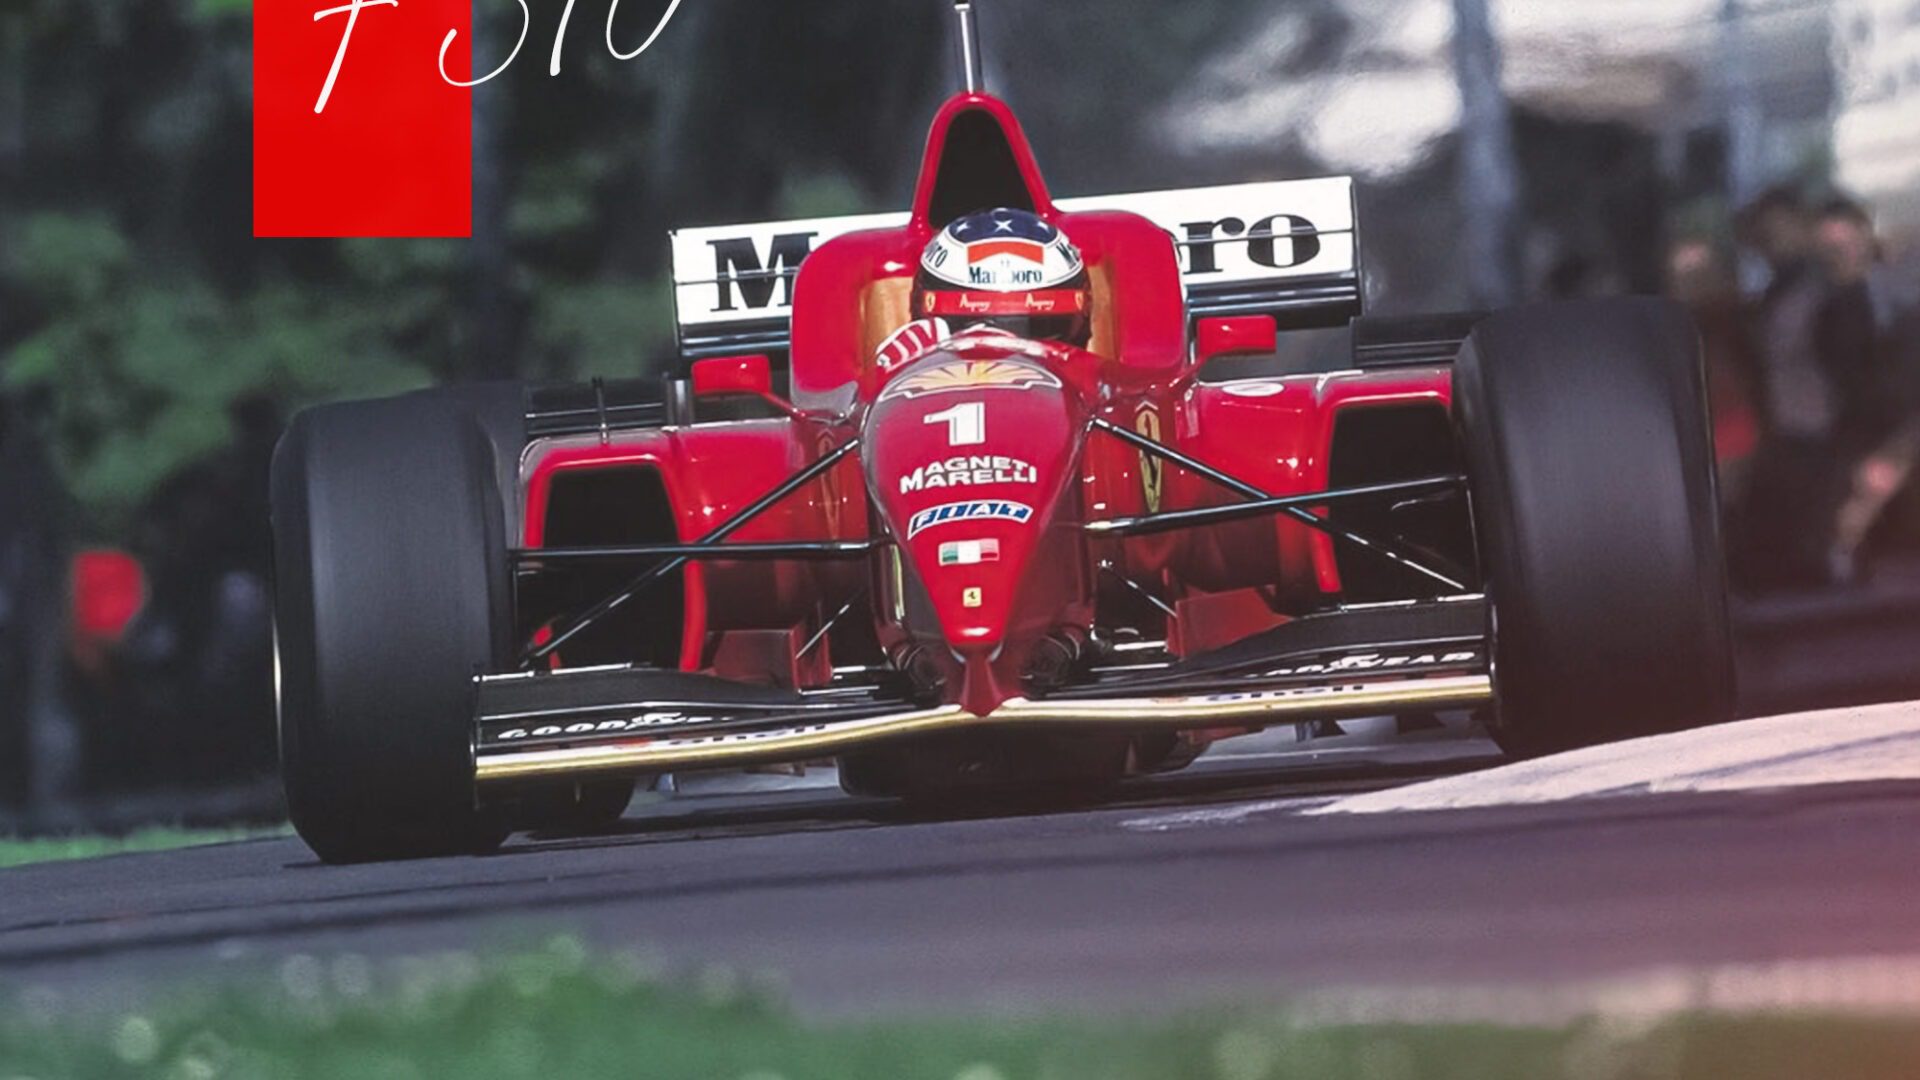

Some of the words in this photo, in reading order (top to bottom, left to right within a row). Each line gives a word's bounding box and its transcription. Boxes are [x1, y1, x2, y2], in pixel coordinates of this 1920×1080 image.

[968, 266, 1043, 284] Maoro
[923, 402, 986, 446] 1
[900, 466, 1037, 494] MARELLI
[911, 502, 1029, 531] FIAT
